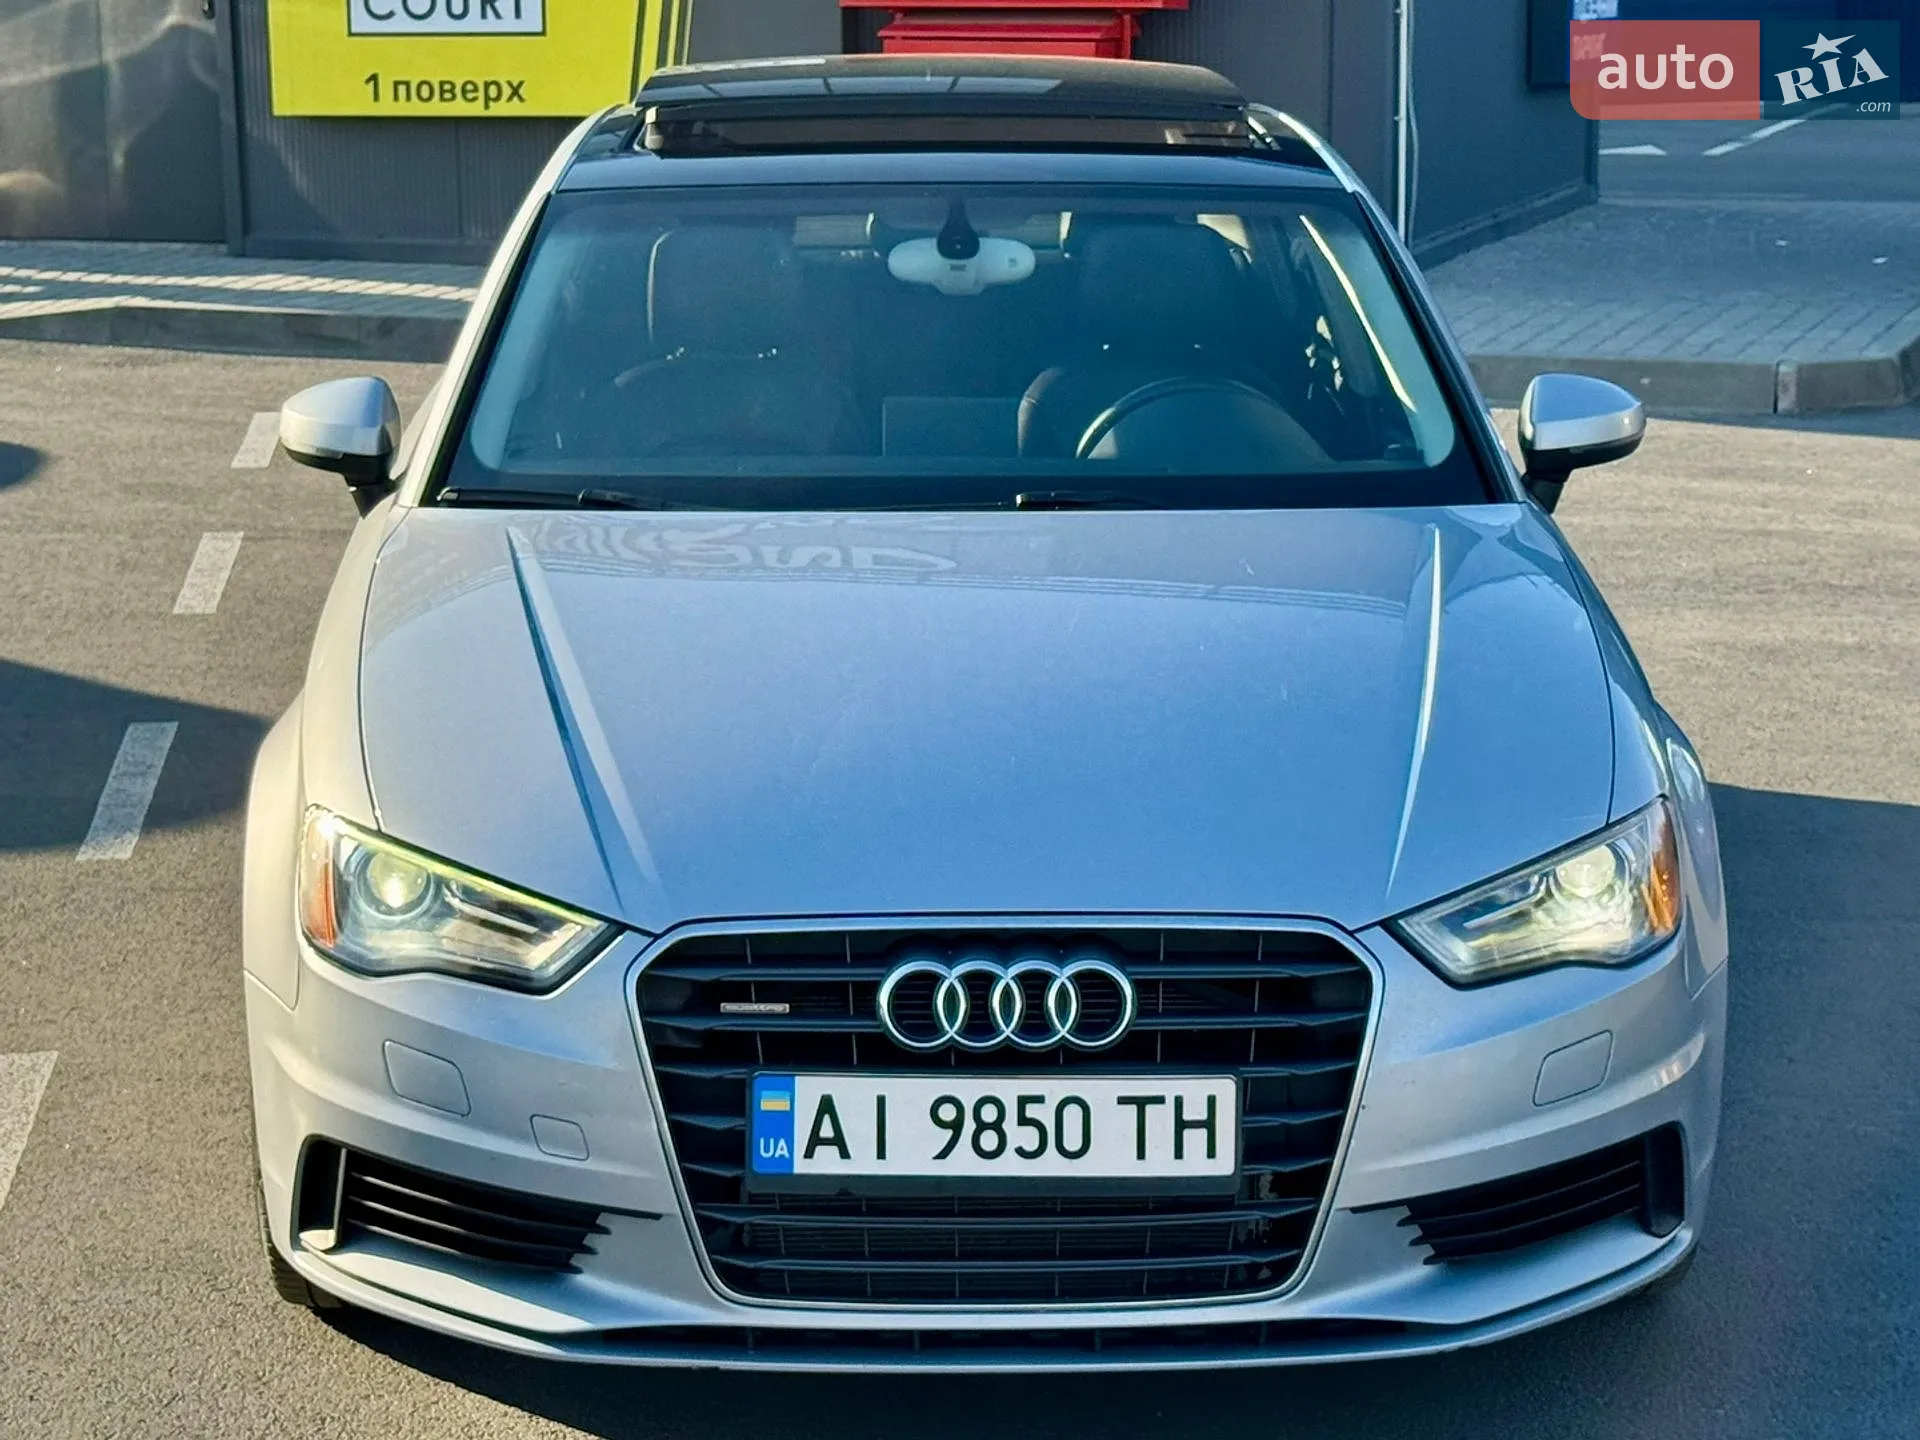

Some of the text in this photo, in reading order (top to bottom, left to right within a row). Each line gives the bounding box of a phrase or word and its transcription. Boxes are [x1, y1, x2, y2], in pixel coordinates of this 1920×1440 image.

[364, 72, 526, 110] 1 поверх
[803, 1094, 1217, 1160] AI 9850 TH
[760, 1138, 789, 1159] UA
